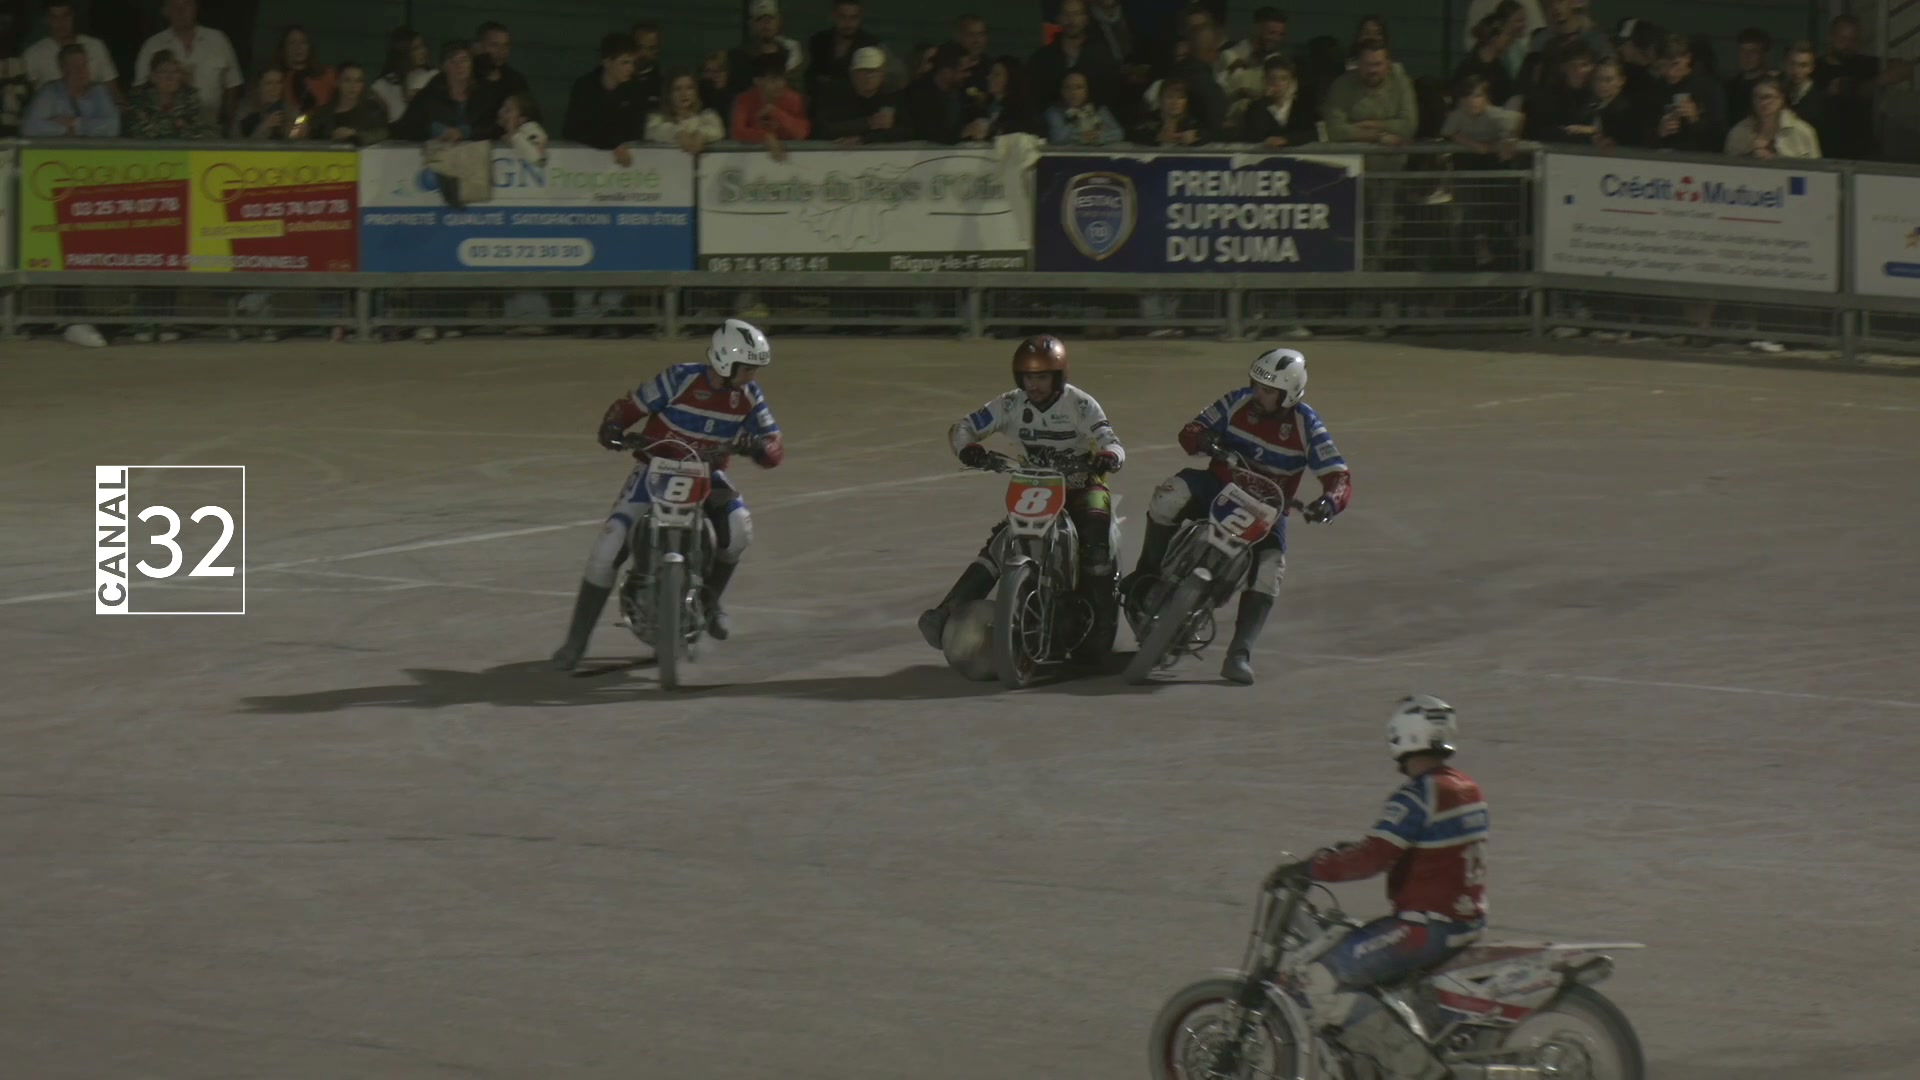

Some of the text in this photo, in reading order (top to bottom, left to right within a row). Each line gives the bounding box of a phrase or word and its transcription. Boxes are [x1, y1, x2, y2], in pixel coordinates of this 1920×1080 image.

[552, 167, 661, 190] Propreté
[1167, 170, 1292, 197] PREMIER
[1600, 173, 1785, 208] Crédit Mutuel
[95, 201, 115, 215] 25
[264, 202, 284, 217] 25
[510, 212, 612, 226] SATISFACTION
[1165, 202, 1330, 230] SUPPORTER
[67, 254, 164, 267] PARTICULIERS
[166, 254, 179, 267] &
[493, 246, 512, 257] 25
[515, 246, 535, 257] 72
[1166, 235, 1301, 262] DU SUMA
[1254, 447, 1264, 461] 2
[664, 476, 694, 502] 8
[1014, 487, 1053, 514] 8
[1221, 507, 1256, 536] 2
